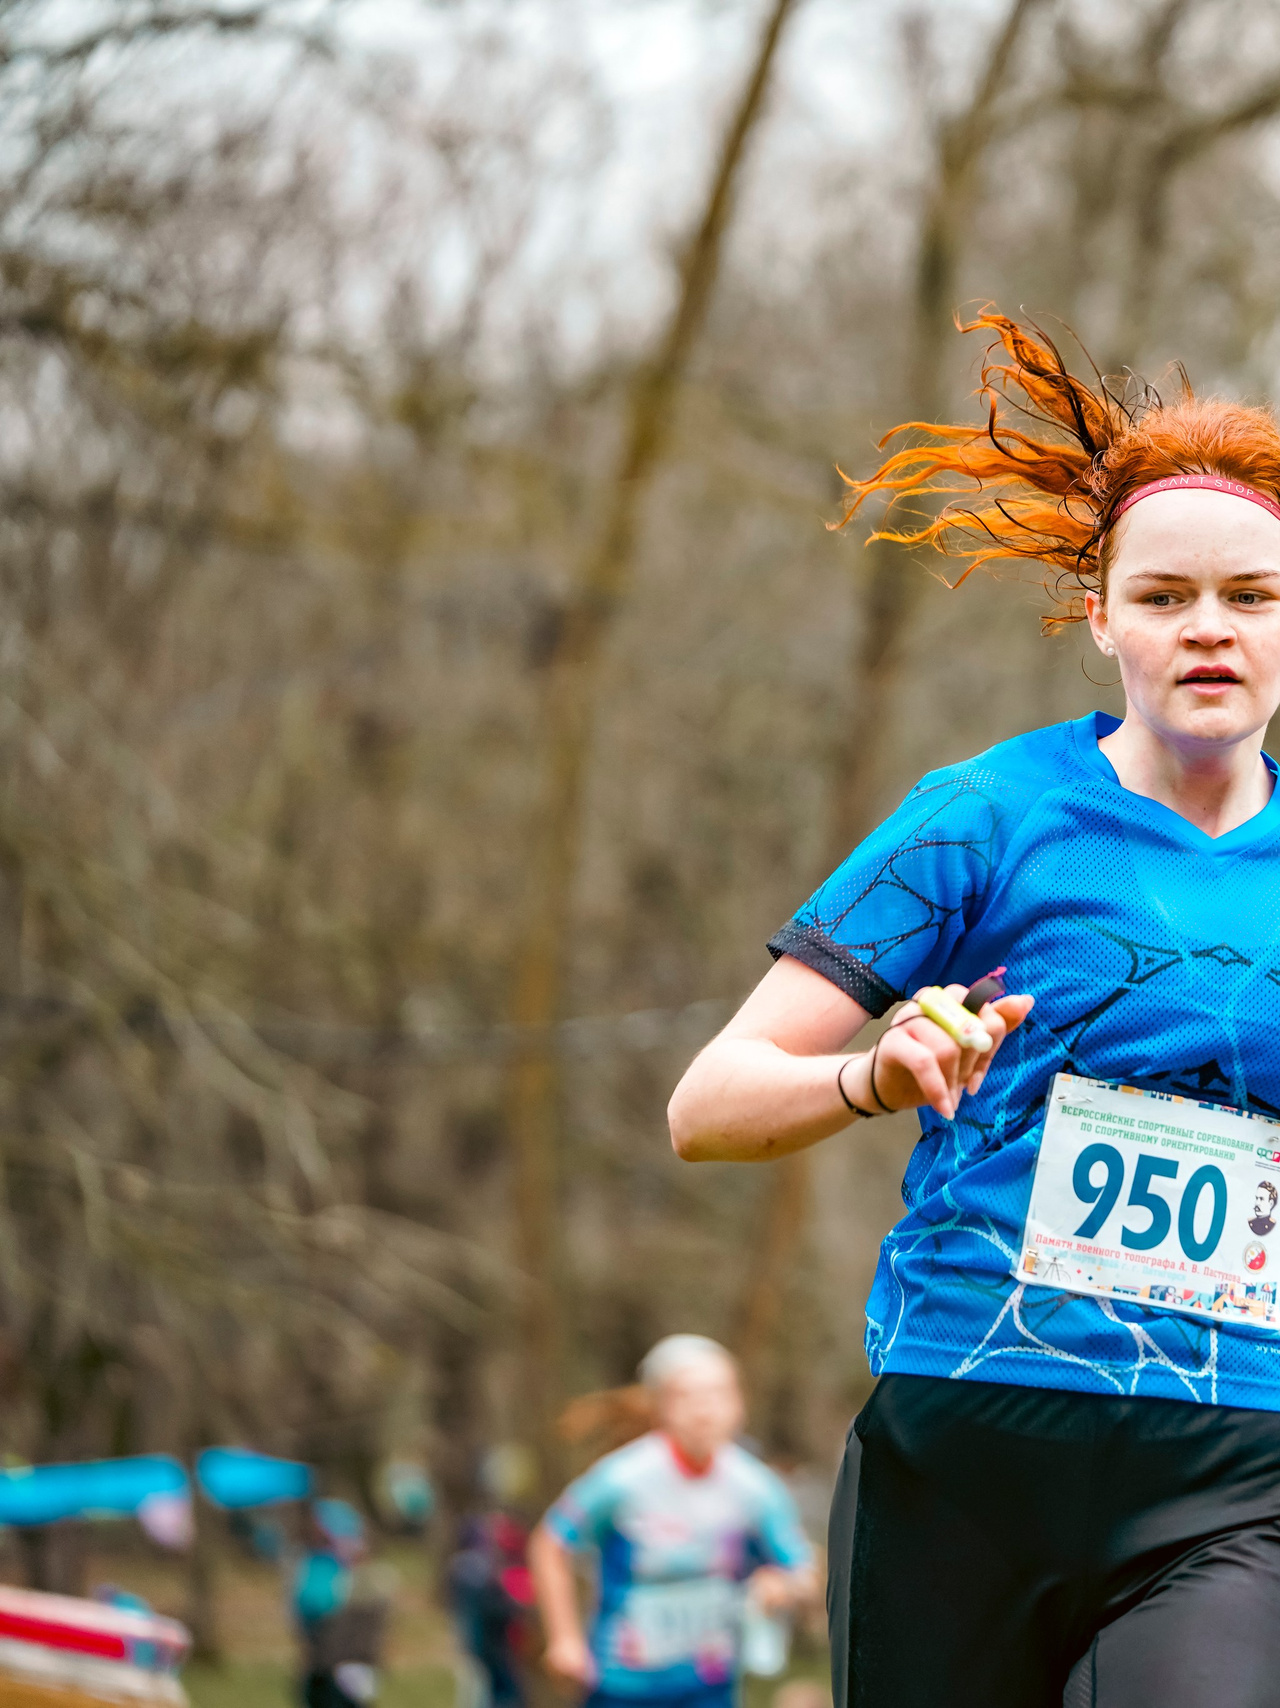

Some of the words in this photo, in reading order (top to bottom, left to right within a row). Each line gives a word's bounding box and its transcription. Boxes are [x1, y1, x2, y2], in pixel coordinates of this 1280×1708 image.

[1158, 476, 1206, 488] CAN'T
[1214, 478, 1254, 496] STOP
[1061, 1104, 1136, 1128] ВСЕРОССИЙСКИЕ
[1138, 1119, 1195, 1140] СПОРТИВНЫЕ
[1196, 1131, 1255, 1152] СОРЕВНОВАНИЯ
[1080, 1121, 1093, 1133] ПО
[1095, 1125, 1159, 1145] СПОРТИВНОМУ
[1161, 1137, 1236, 1161] ОРИЕНТИРОВАНИЮ
[1072, 1142, 1228, 1262] 950
[1035, 1233, 1073, 1250] Памяти
[1076, 1243, 1121, 1258] военного
[1124, 1252, 1176, 1270] топографа
[1191, 1264, 1200, 1274] В.
[1203, 1266, 1241, 1284] Пастухова
